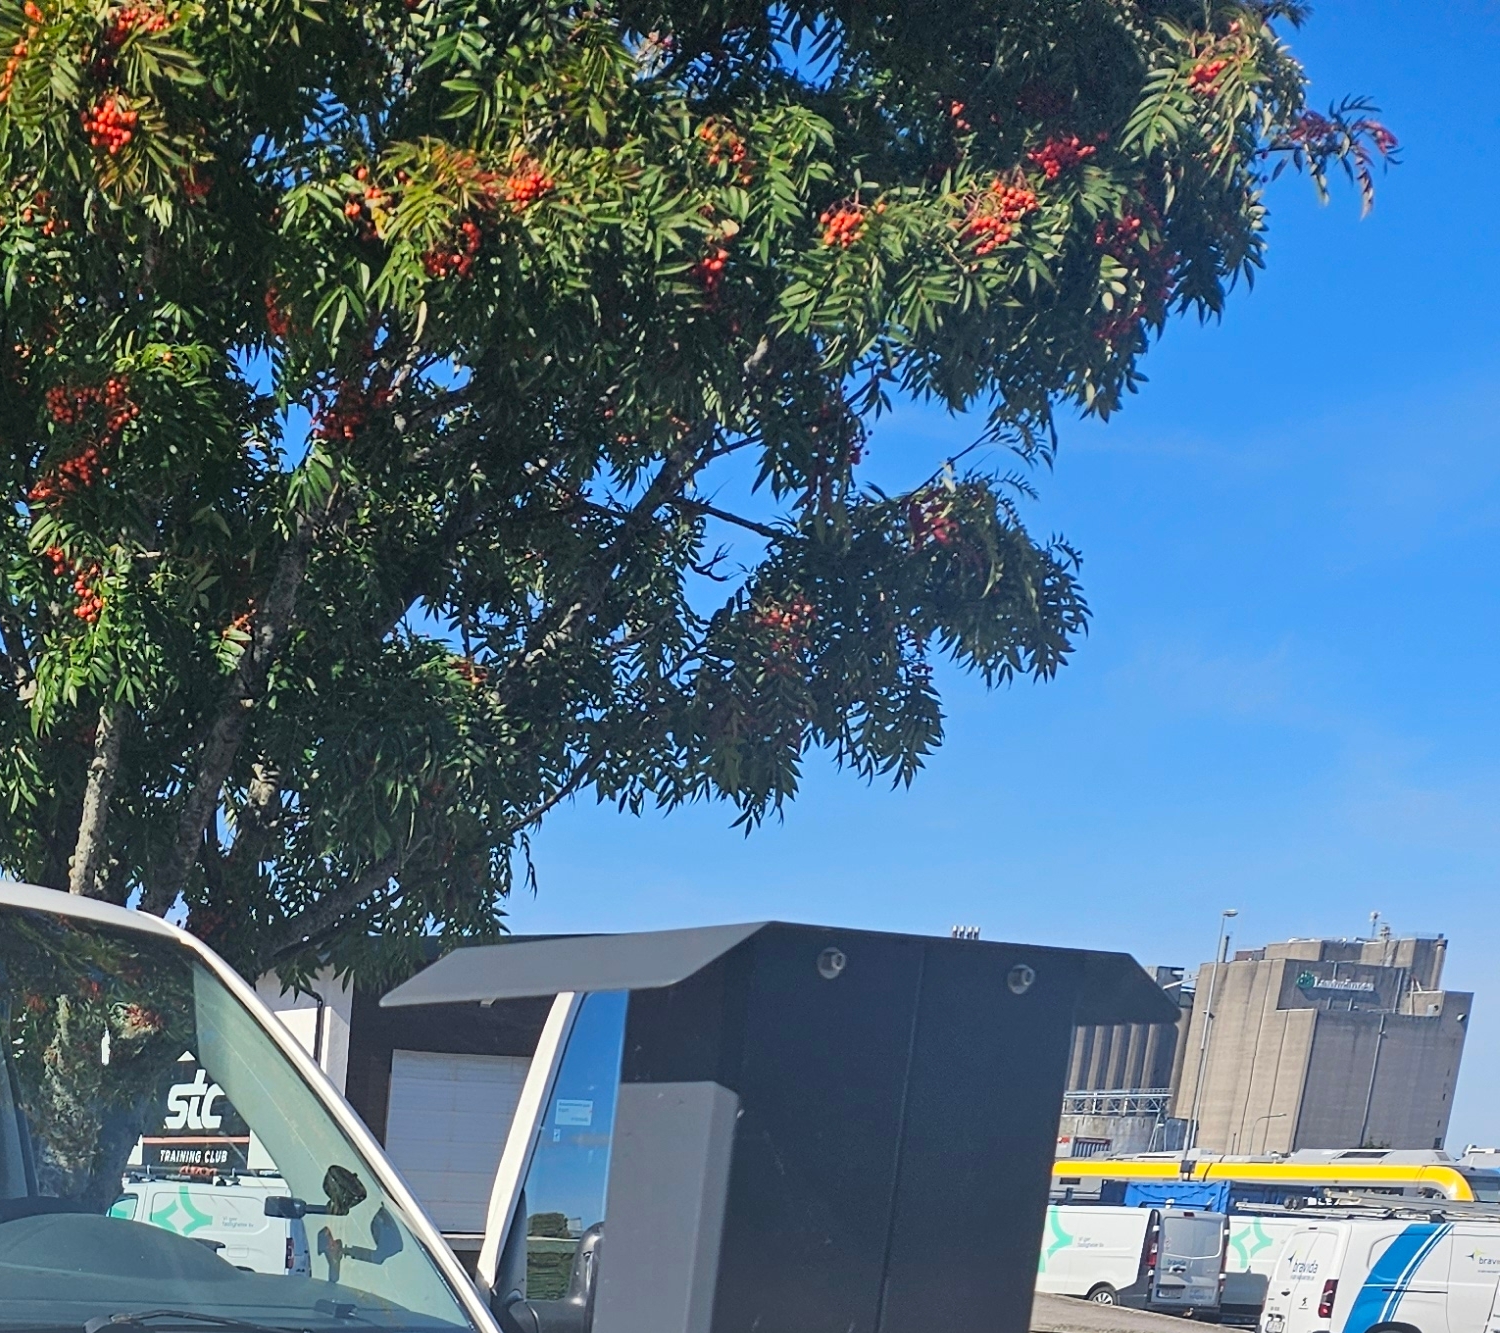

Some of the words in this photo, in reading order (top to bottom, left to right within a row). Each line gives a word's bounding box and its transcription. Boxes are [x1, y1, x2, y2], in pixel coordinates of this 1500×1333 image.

[160, 1150, 201, 1164] TRAINING
[204, 1150, 228, 1163] CLUB
[1292, 1259, 1319, 1273] bravida
